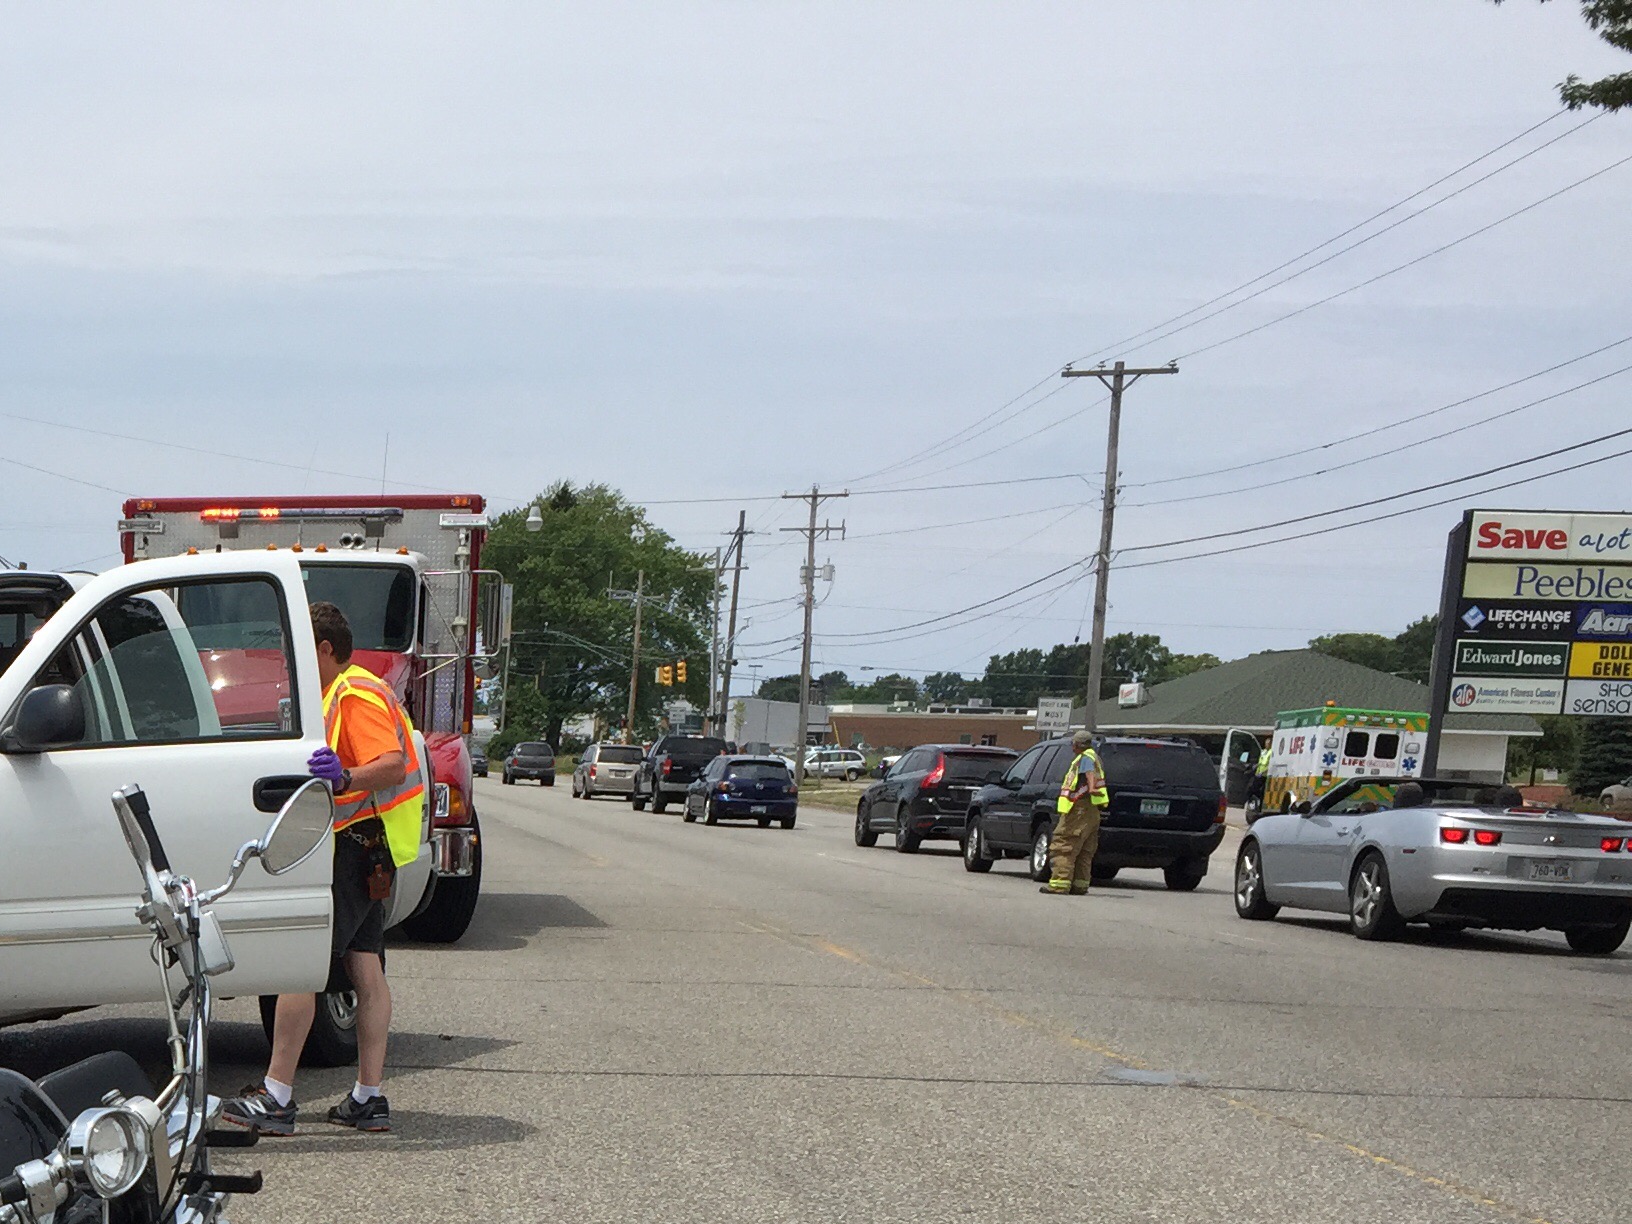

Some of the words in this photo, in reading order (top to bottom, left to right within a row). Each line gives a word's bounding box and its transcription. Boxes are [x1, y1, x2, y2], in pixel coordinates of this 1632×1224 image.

[1477, 521, 1568, 550] Save
[1488, 609, 1572, 623] LIFECHANGE
[1497, 622, 1560, 630] CHURCH
[1289, 736, 1306, 754] LIFE
[1341, 758, 1366, 767] LIFE
